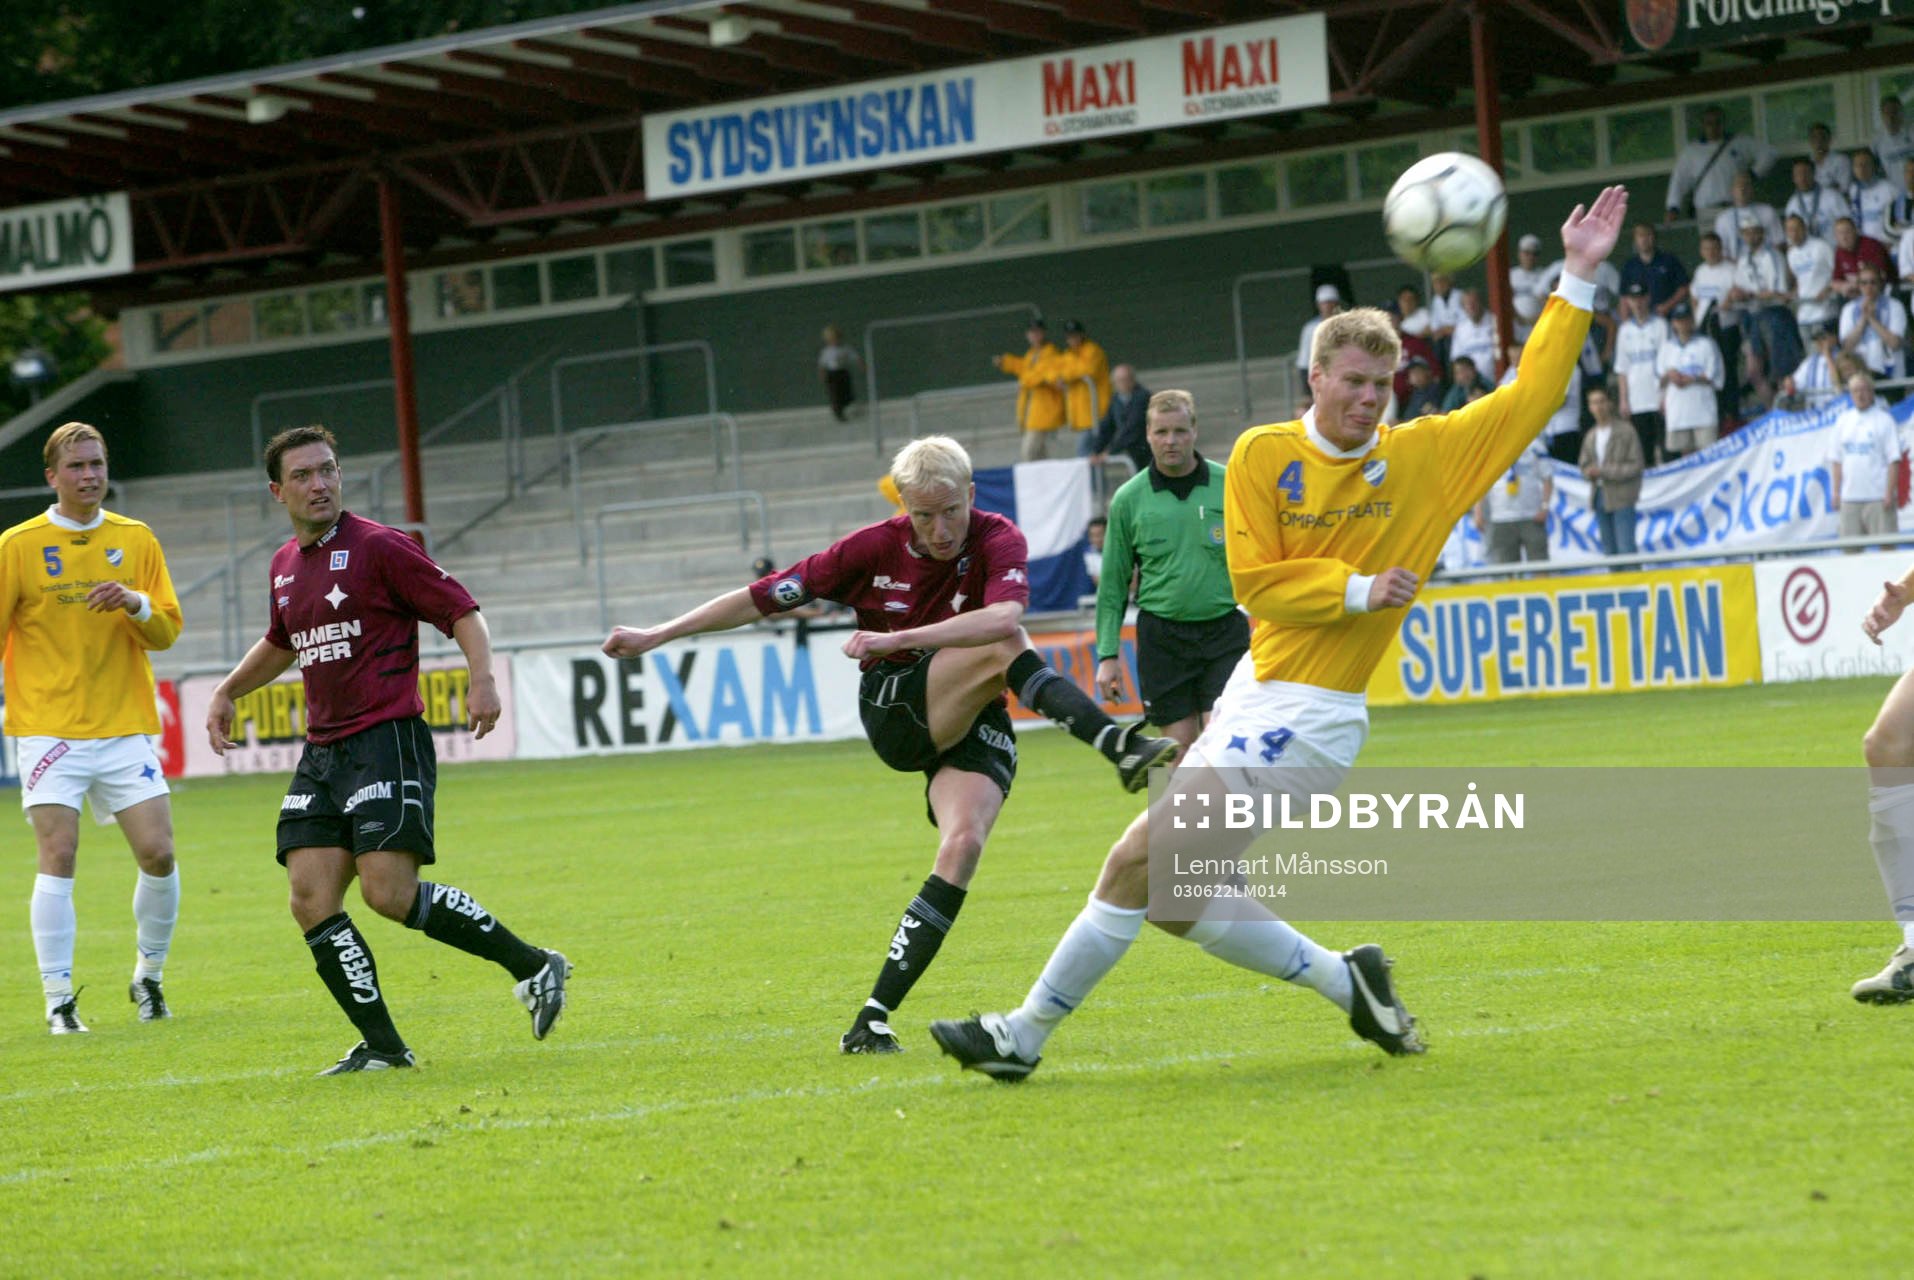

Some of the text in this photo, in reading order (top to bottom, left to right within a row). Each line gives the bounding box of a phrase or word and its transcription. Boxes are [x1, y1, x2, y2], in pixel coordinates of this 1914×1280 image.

[1042, 57, 1137, 117] MAXI
[1178, 36, 1279, 96] MAXI
[666, 77, 976, 186] SYDSVENSKAN
[1277, 460, 1305, 504] 4
[1279, 502, 1392, 530] OMPACT PLATE
[43, 545, 63, 577] 5
[289, 619, 362, 651] OLMEN
[298, 640, 353, 669] APER
[1400, 582, 1727, 698] SUPERETTAN
[230, 682, 308, 742] PORT
[570, 644, 823, 748] REXAM
[1259, 726, 1296, 766] 4
